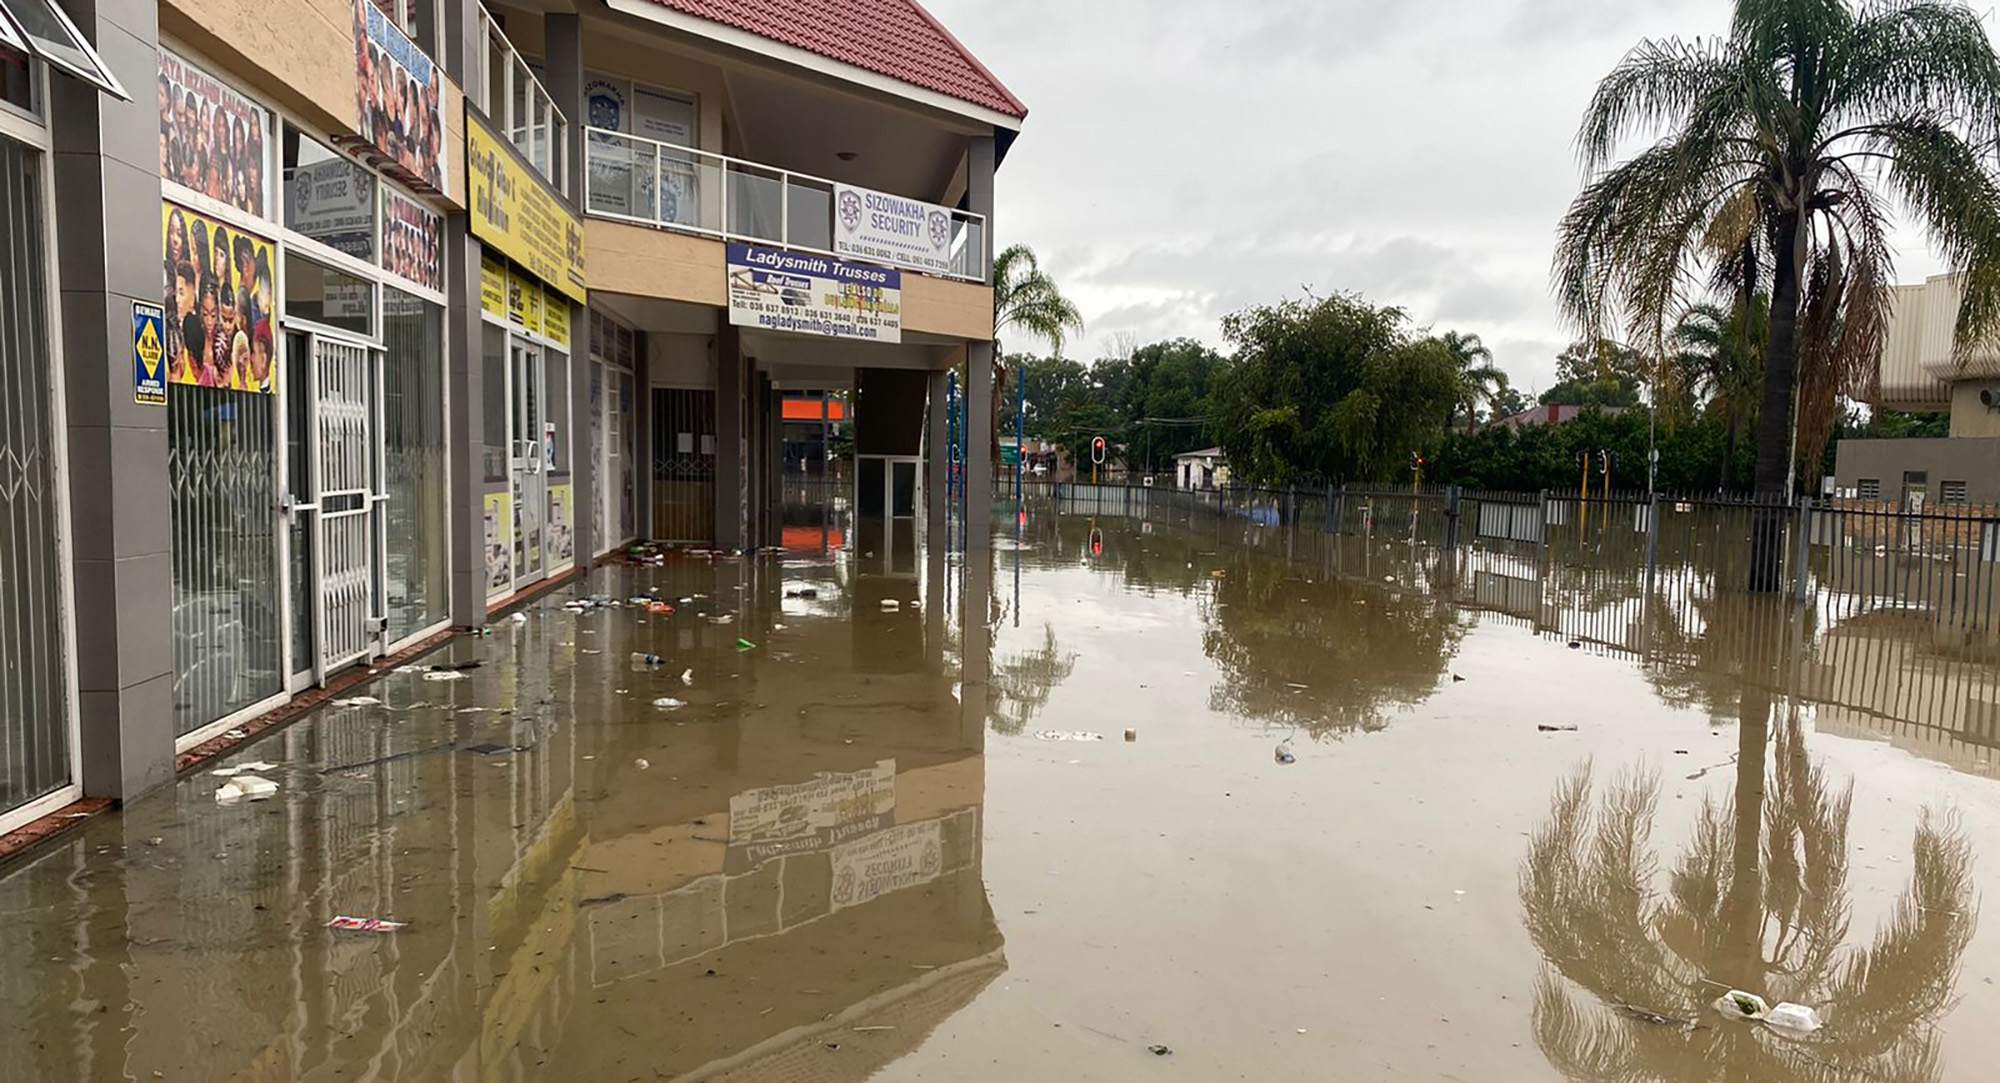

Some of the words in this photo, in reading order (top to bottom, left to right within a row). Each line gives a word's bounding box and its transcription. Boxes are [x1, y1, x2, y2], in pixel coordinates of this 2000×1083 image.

[865, 193, 926, 222] SIZOWAKHA
[871, 212, 921, 238] SECURITY
[746, 248, 828, 274] Ladysmith
[832, 261, 887, 283] Trusses
[767, 273, 785, 287] Roof
[786, 276, 810, 289] Trusses
[732, 299, 748, 310] Tell:
[749, 301, 764, 312] 036
[765, 303, 780, 313] 637
[804, 308, 818, 318] 036
[759, 314, 877, 338] nagladysmith@gmail.com
[142, 335, 160, 351] N.N.
